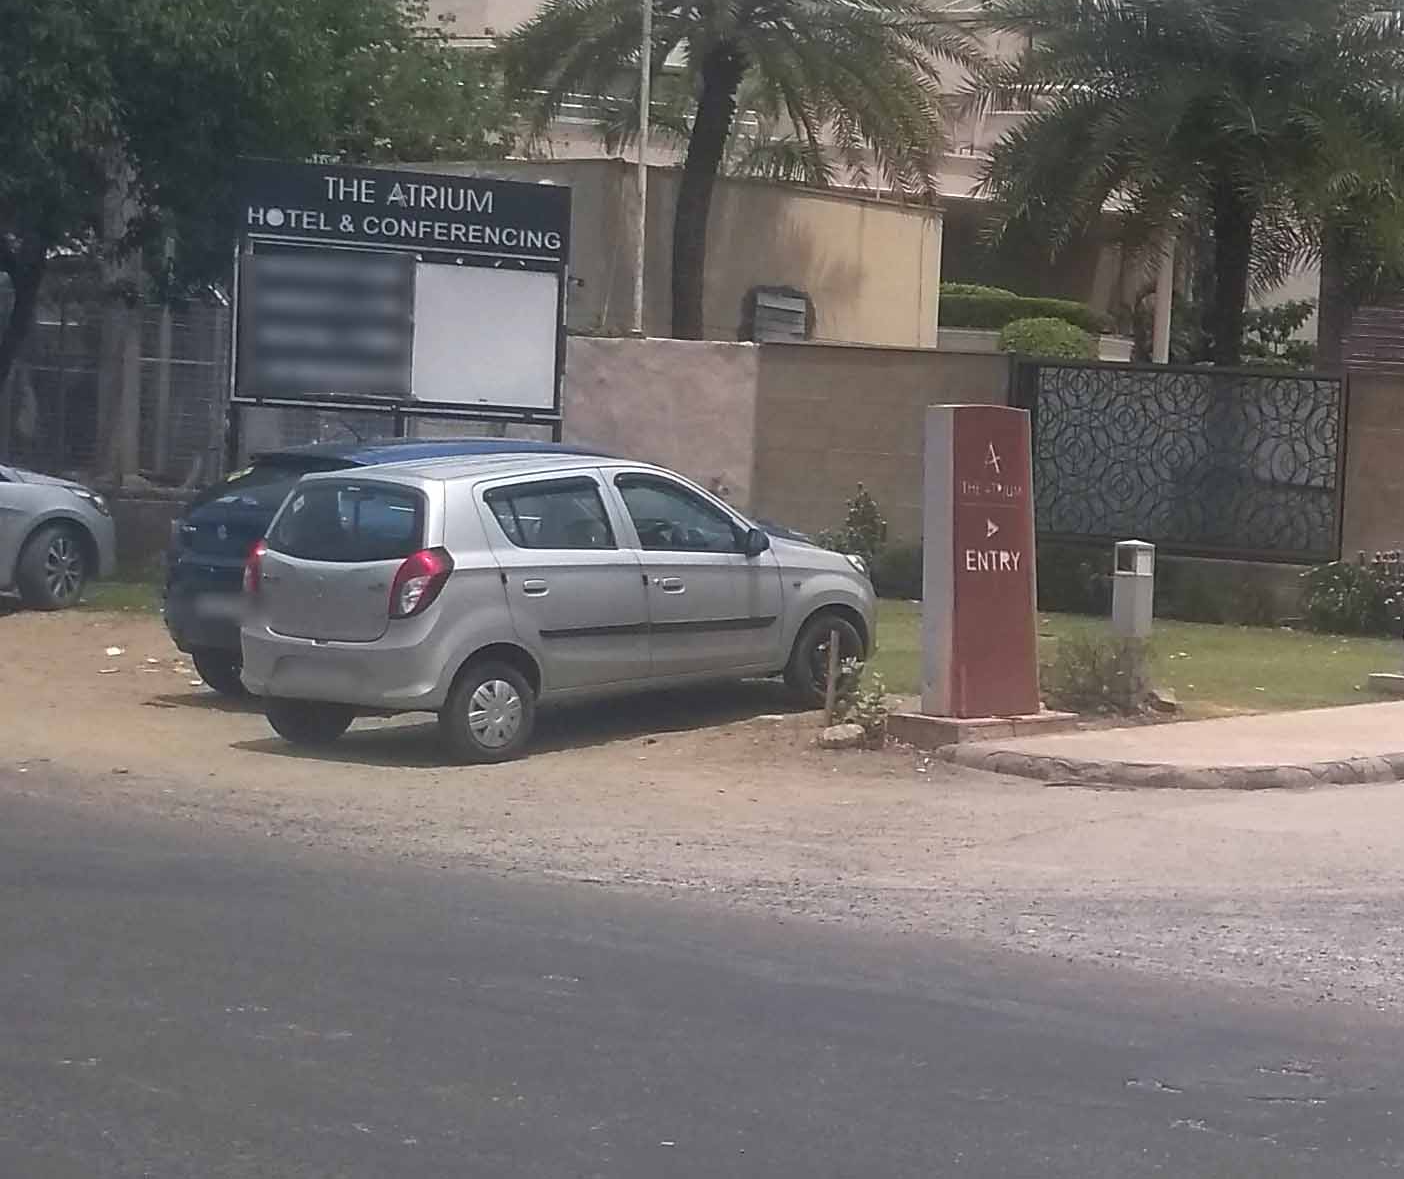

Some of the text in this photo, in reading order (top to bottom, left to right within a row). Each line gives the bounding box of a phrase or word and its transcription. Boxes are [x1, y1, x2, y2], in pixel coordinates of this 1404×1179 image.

[323, 176, 494, 213] THE ATRIUM
[247, 206, 562, 250] HOTEL & CONFERENCING
[984, 482, 1022, 498] TIUM
[965, 549, 1021, 571] ENTRY
